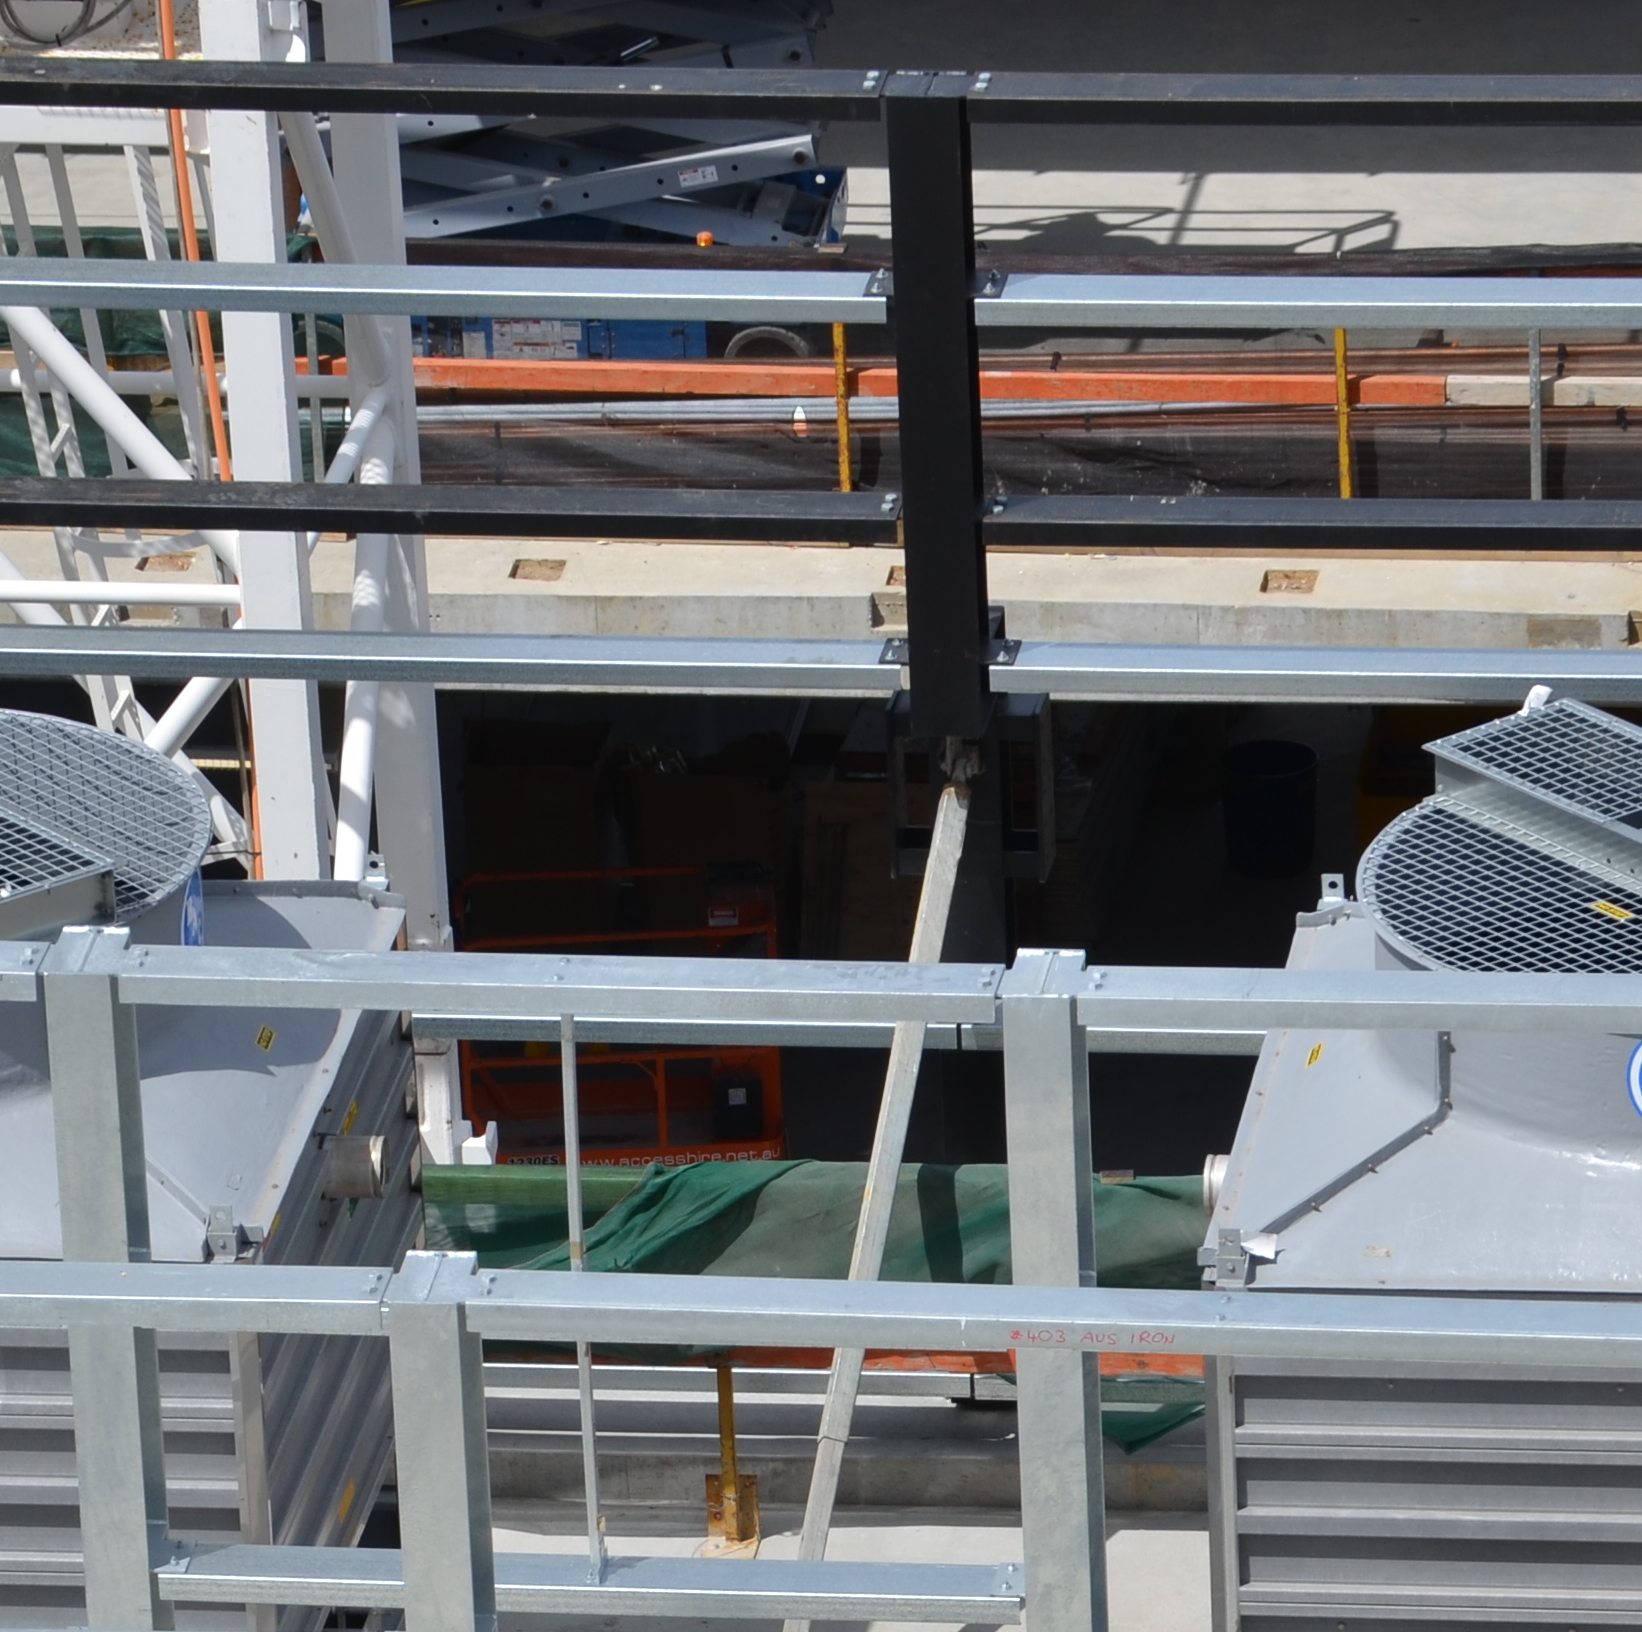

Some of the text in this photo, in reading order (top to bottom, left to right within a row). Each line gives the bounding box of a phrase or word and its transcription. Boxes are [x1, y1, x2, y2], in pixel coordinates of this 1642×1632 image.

[1009, 1329, 1176, 1346] #403 AUS IRON
